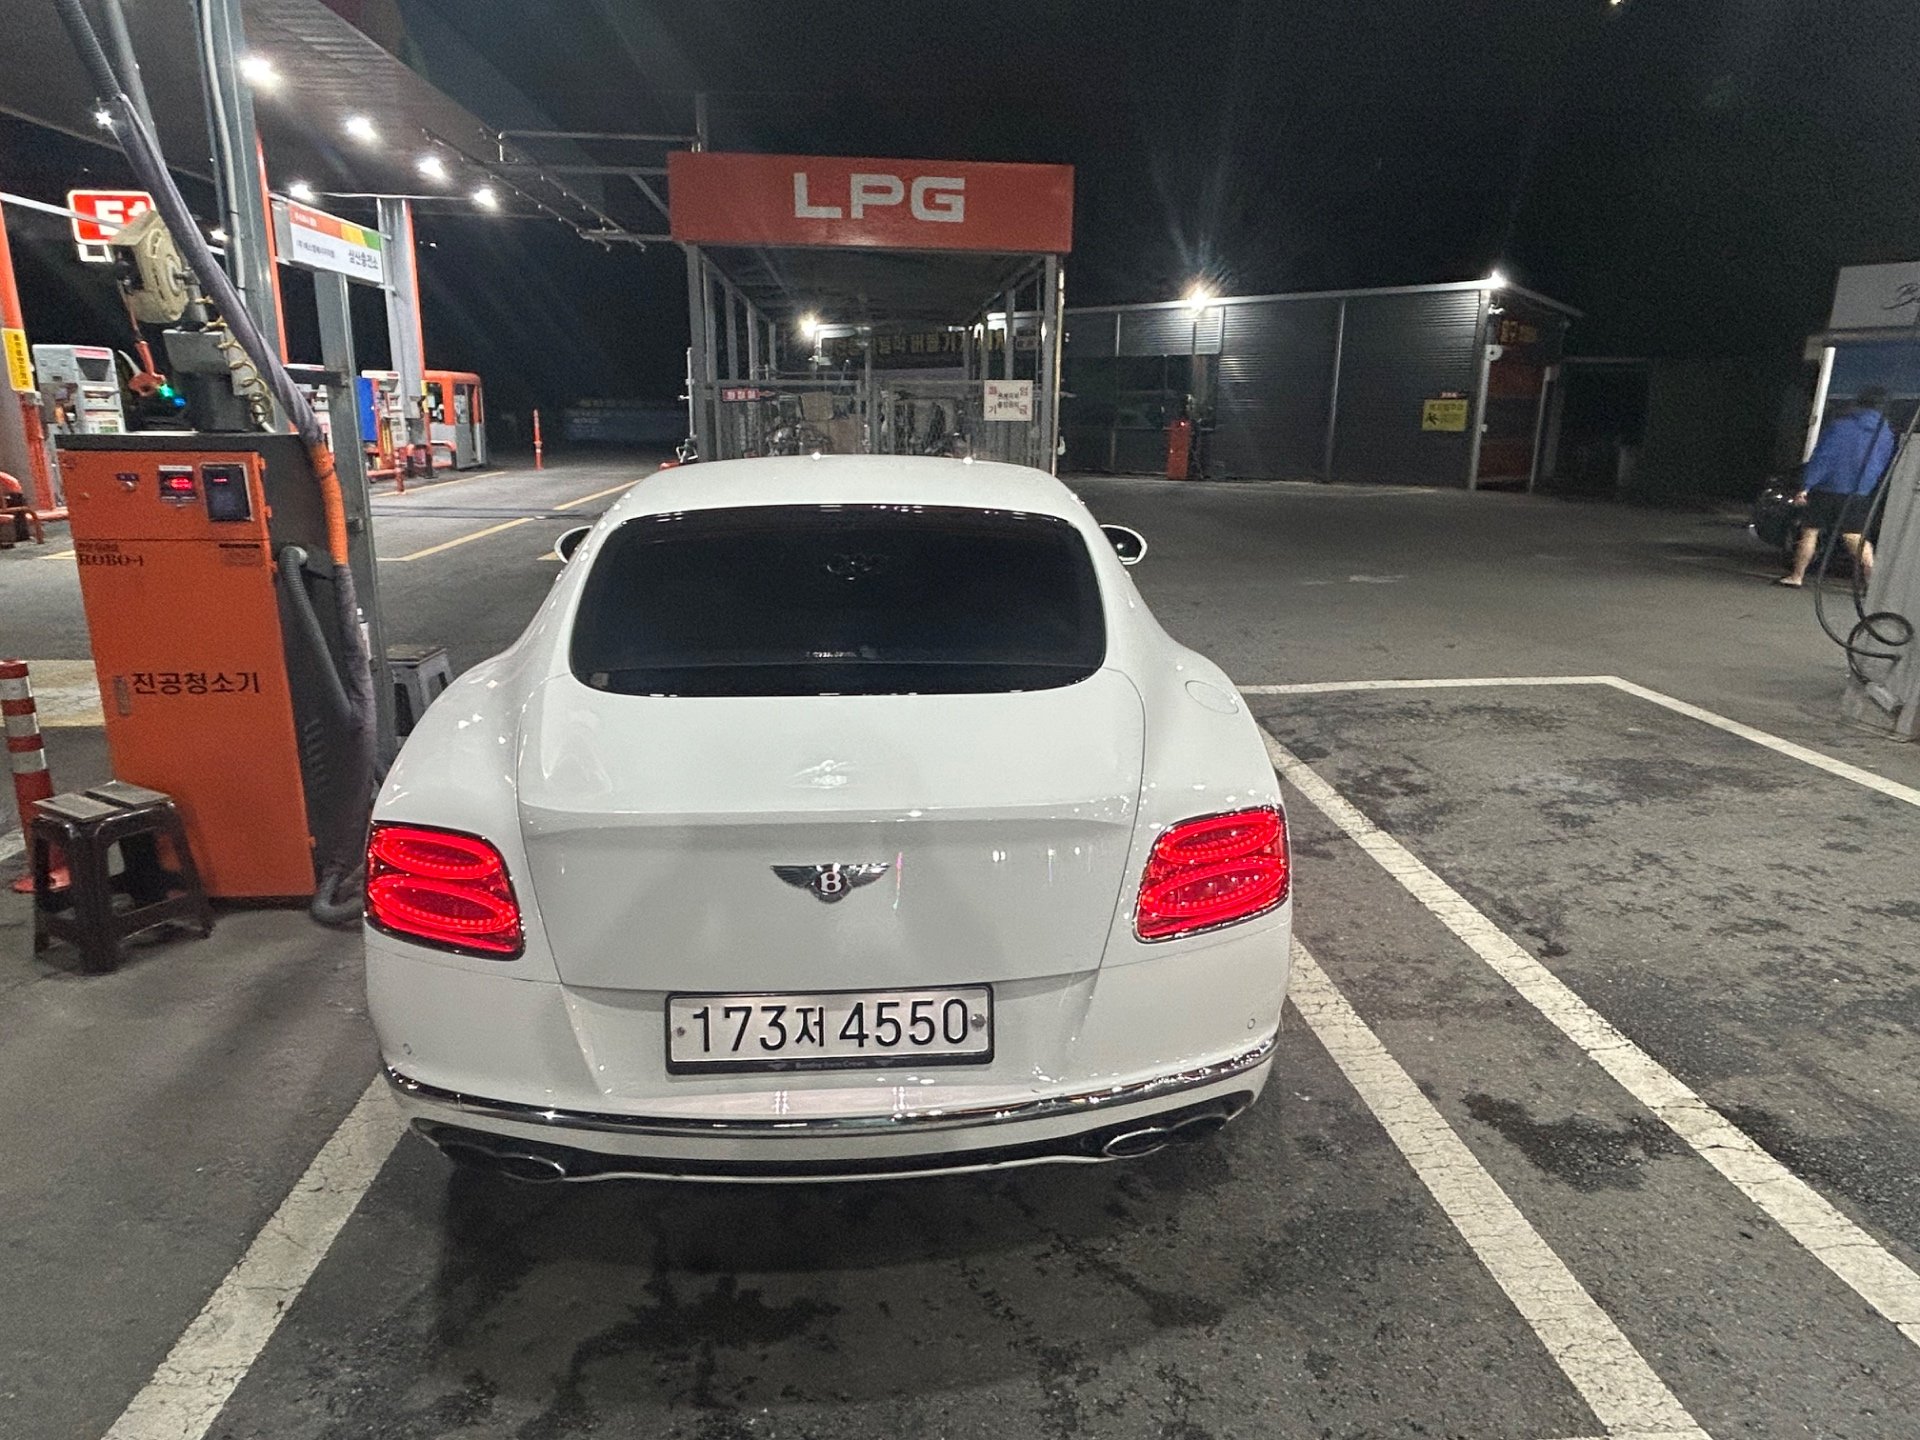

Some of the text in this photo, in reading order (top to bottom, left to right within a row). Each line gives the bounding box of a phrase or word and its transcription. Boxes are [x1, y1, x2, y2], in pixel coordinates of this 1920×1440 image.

[793, 172, 966, 223] LPG
[131, 672, 260, 695] 진공청소기
[838, 998, 969, 1048] 4550
